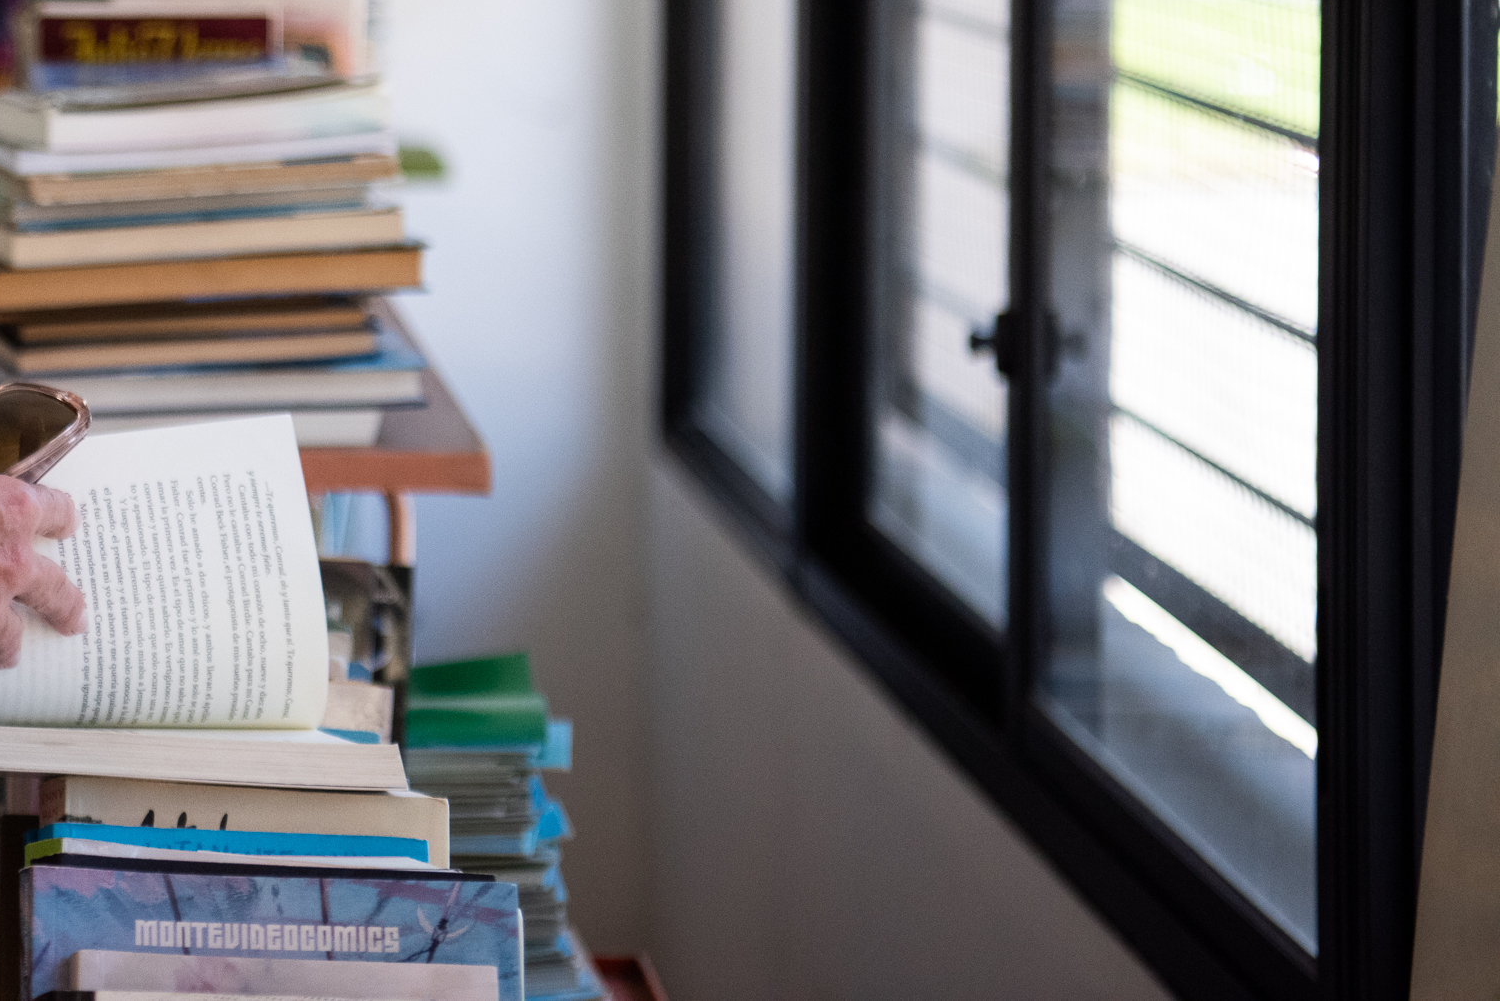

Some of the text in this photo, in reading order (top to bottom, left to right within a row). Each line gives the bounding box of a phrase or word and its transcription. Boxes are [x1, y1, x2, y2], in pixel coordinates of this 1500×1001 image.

[88, 489, 98, 506] que
[104, 487, 112, 496] el
[130, 485, 136, 494] to
[157, 482, 166, 504] amar
[170, 480, 180, 510] Fisher.
[186, 490, 195, 511] Solo
[197, 477, 206, 506] centes.
[210, 475, 222, 508] Conrad
[250, 478, 260, 509] siempre
[144, 483, 155, 523] conviene
[161, 507, 168, 515] la
[227, 496, 233, 508] no
[238, 485, 250, 521] Cantaba
[93, 508, 102, 522] fui.
[103, 498, 117, 533] pasado,
[121, 508, 129, 533] luego
[190, 513, 197, 525] he
[216, 510, 226, 532] Beck
[256, 511, 262, 519] te
[82, 522, 90, 538] dos
[112, 535, 120, 544] el
[132, 504, 148, 559] apasionado.
[160, 516, 173, 553] primera
[176, 513, 188, 547] Conrad
[231, 520, 242, 554] cantaba
[257, 520, 267, 553] seremos
[71, 531, 82, 576] onvertiría
[96, 524, 107, 562] Conocía
[125, 535, 135, 564] estaba
[152, 533, 162, 573] tampoco
[192, 528, 203, 560] amado
[220, 533, 229, 564] Fisher,
[248, 542, 257, 563] todo
[82, 540, 96, 577] grandes
[110, 546, 124, 585] presente
[142, 561, 151, 571] El
[260, 554, 272, 577] fieles.
[103, 571, 111, 584] mi
[184, 567, 192, 576] el
[225, 566, 232, 574] el
[238, 564, 249, 597] Conrad
[252, 566, 258, 577] mi
[103, 586, 111, 598] yo
[128, 566, 141, 610] Jeremiah.
[142, 573, 151, 592] tipo
[156, 575, 166, 604] quiere
[172, 576, 180, 588] Es
[174, 589, 182, 597] el
[266, 504, 278, 544] queremos,
[275, 546, 286, 579] Conrad,
[283, 599, 291, 621] tanto
[287, 650, 295, 661] Te
[90, 578, 99, 614] amores.
[106, 599, 114, 611] de
[120, 596, 128, 605] el
[147, 594, 154, 606] de
[184, 578, 195, 615] primero
[224, 576, 238, 632] protagonista
[254, 580, 264, 616] corazón
[173, 599, 182, 618] tipo
[243, 599, 252, 628] Birdie.
[94, 615, 102, 637] Creo
[108, 613, 116, 638] ahora
[121, 607, 129, 638] futuro.
[135, 612, 145, 648] Cuando
[162, 605, 171, 640] saberlo.
[177, 620, 185, 631] de
[191, 626, 199, 635] lo
[258, 618, 266, 629] de
[94, 638, 103, 655] que
[124, 641, 132, 655] No
[148, 633, 157, 650] que
[165, 642, 173, 653] Es
[192, 638, 200, 656] amé
[205, 634, 214, 663] ambos
[232, 633, 240, 644] de
[246, 631, 254, 667] Cantaba
[259, 631, 267, 655] ocho,
[83, 651, 91, 664] Lo
[110, 648, 117, 662] me
[124, 657, 132, 675] solo
[138, 650, 146, 680] miraba
[151, 652, 160, 670] solo
[177, 657, 185, 674] que
[81, 666, 90, 682] que
[95, 656, 104, 690] siempre
[108, 664, 118, 689] quería
[163, 655, 173, 700] vertiginoso
[179, 675, 185, 686] no
[206, 666, 215, 691] llevan
[192, 684, 200, 700] solo
[246, 688, 252, 698] mi
